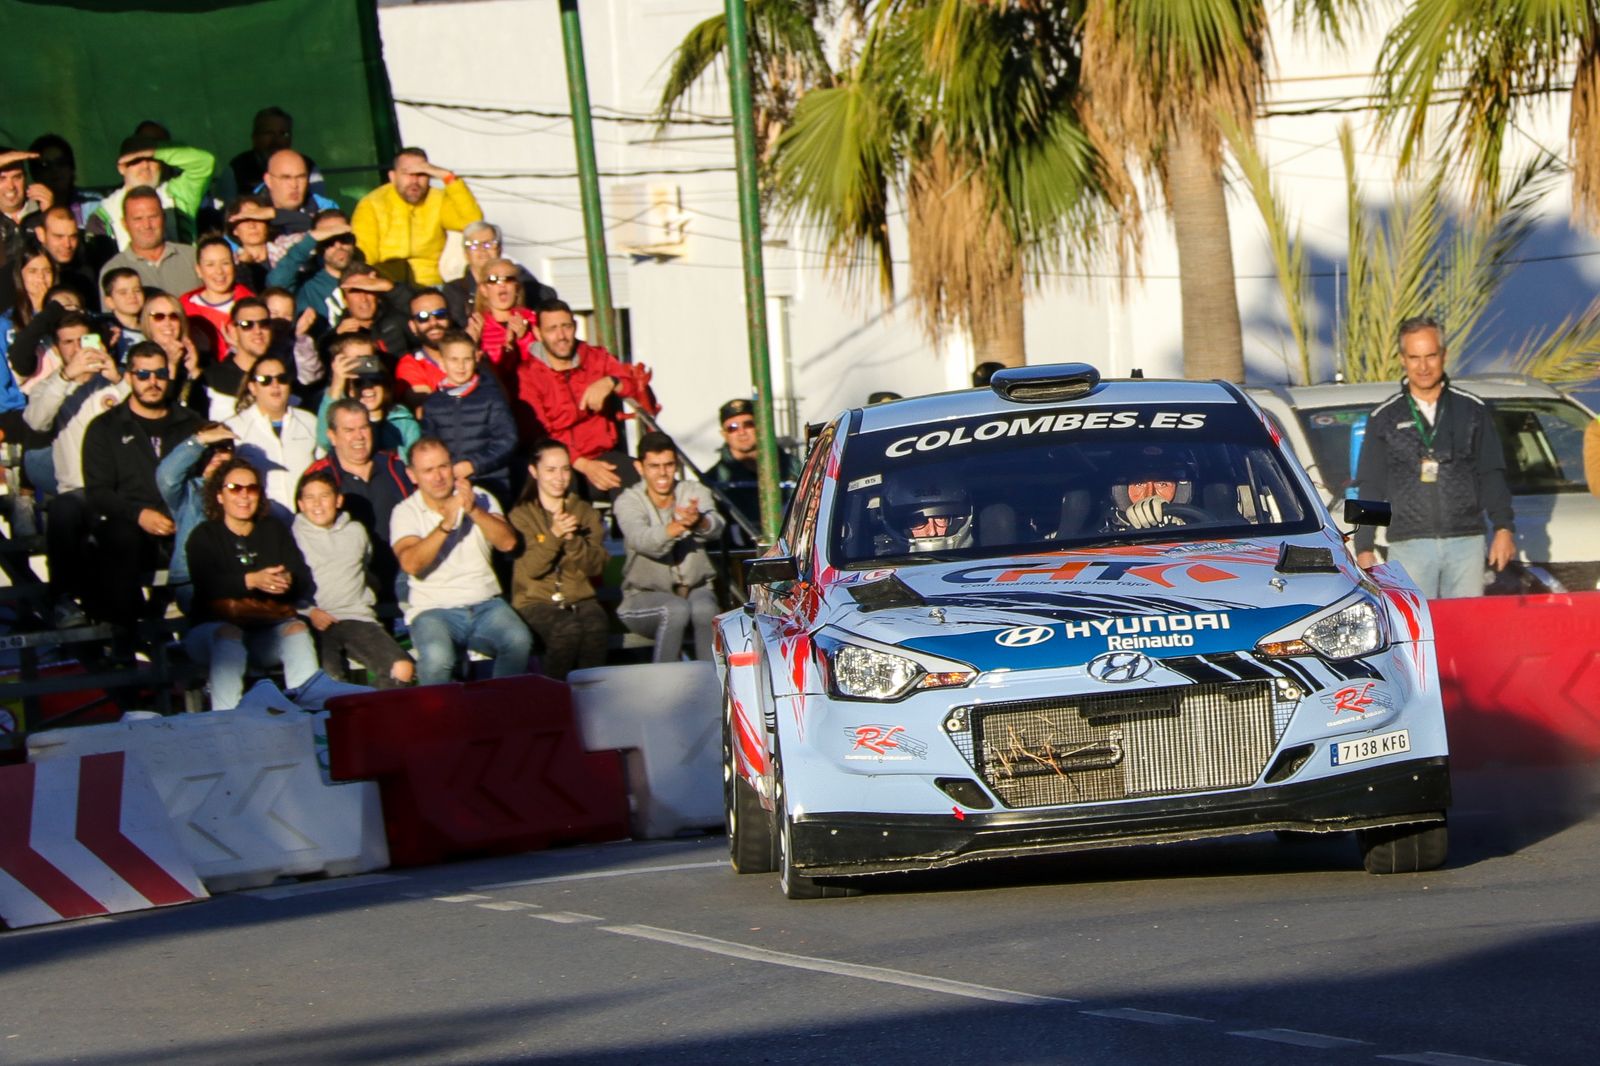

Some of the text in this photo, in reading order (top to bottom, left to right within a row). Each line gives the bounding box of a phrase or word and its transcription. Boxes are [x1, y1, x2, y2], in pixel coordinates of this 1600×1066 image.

[885, 411, 1207, 457] COLOMBES.ES
[960, 580, 1058, 588] Combustibles
[1065, 613, 1231, 639] HYUNDAI
[1107, 633, 1194, 651] Reinauto
[1343, 734, 1406, 760] 7138 KFG
